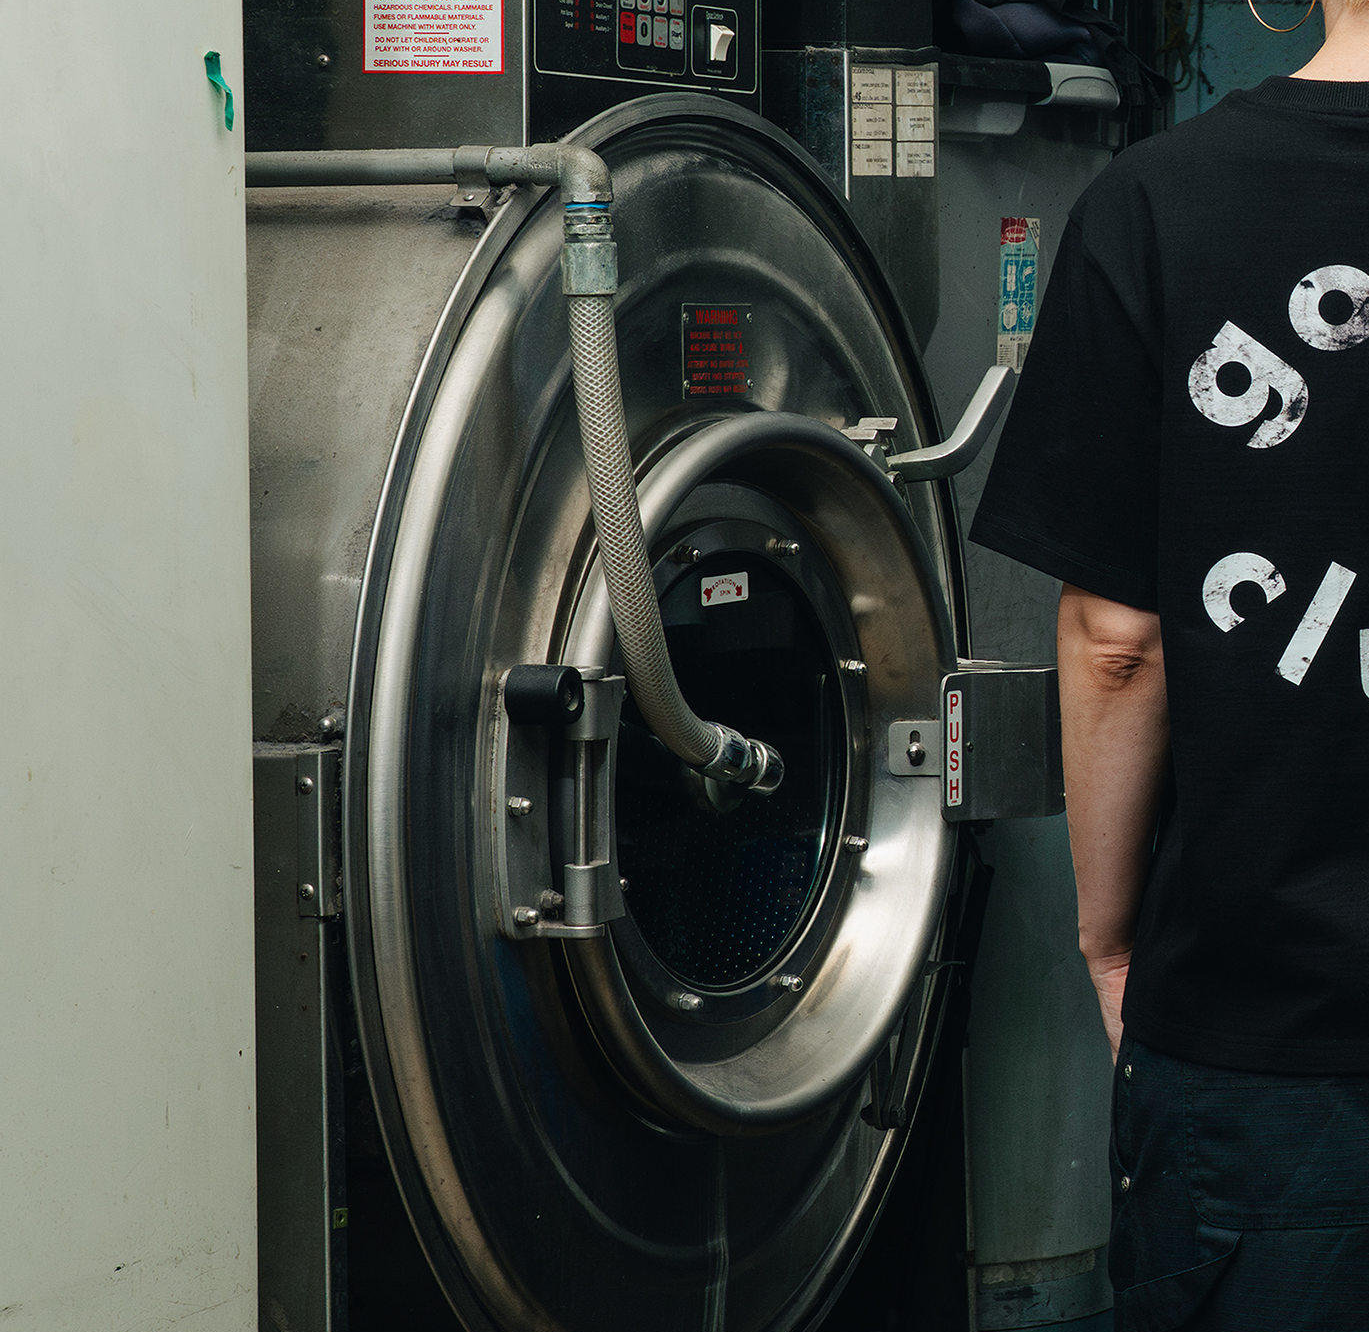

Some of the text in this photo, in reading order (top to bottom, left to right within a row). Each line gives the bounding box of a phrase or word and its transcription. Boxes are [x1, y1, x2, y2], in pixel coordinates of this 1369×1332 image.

[640, 22, 648, 38] 0
[373, 59, 494, 68] SERIOUS INJURY MAY RESULT
[695, 309, 738, 325] WARNING
[712, 578, 737, 590] ROTATION
[949, 693, 960, 800] PUSH
